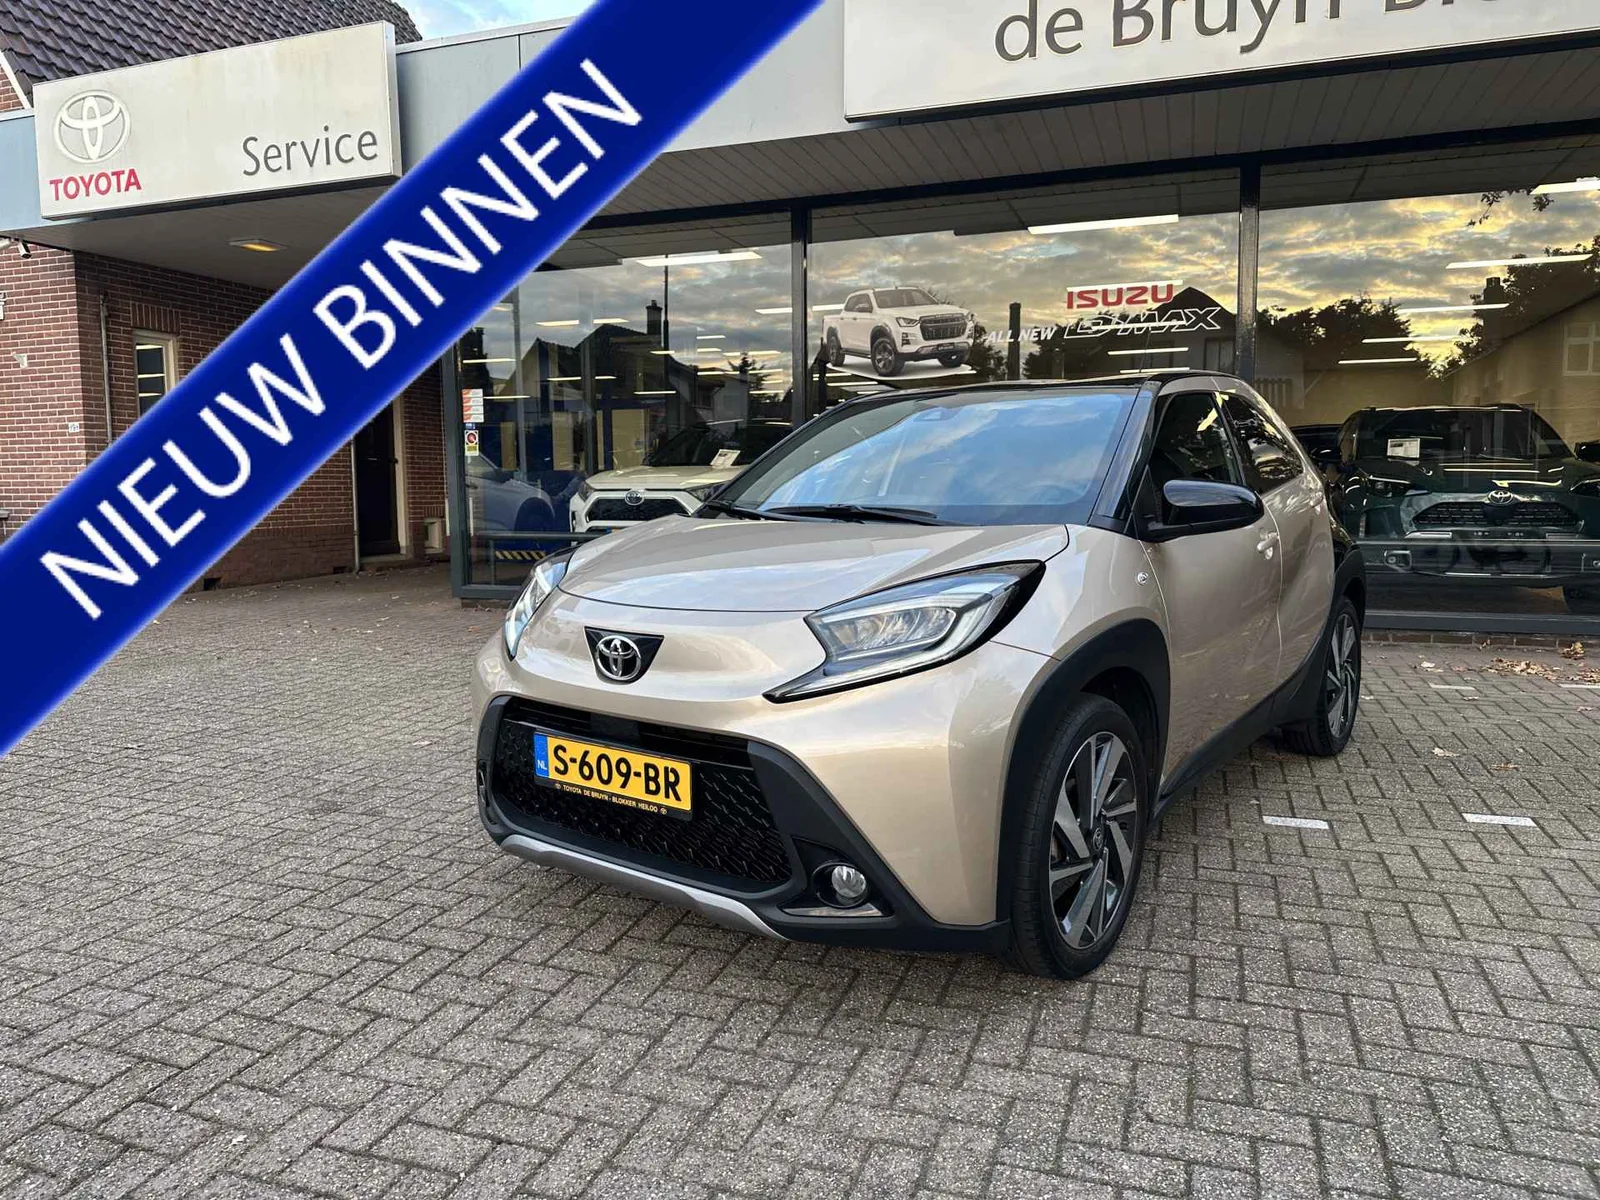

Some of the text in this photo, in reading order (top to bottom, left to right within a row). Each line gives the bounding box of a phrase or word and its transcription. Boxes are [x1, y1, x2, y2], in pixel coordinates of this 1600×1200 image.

[995, 0, 1083, 62] de
[242, 125, 378, 177] Service
[50, 168, 142, 201] TOYOTA
[1066, 283, 1174, 310] ISUZU
[985, 329, 1014, 345] ALL
[1018, 326, 1057, 341] NEW
[537, 759, 548, 771] NL
[553, 744, 682, 802] S-609-BR
[563, 784, 582, 795] TOYOTA
[612, 795, 637, 808] BLOKKER
